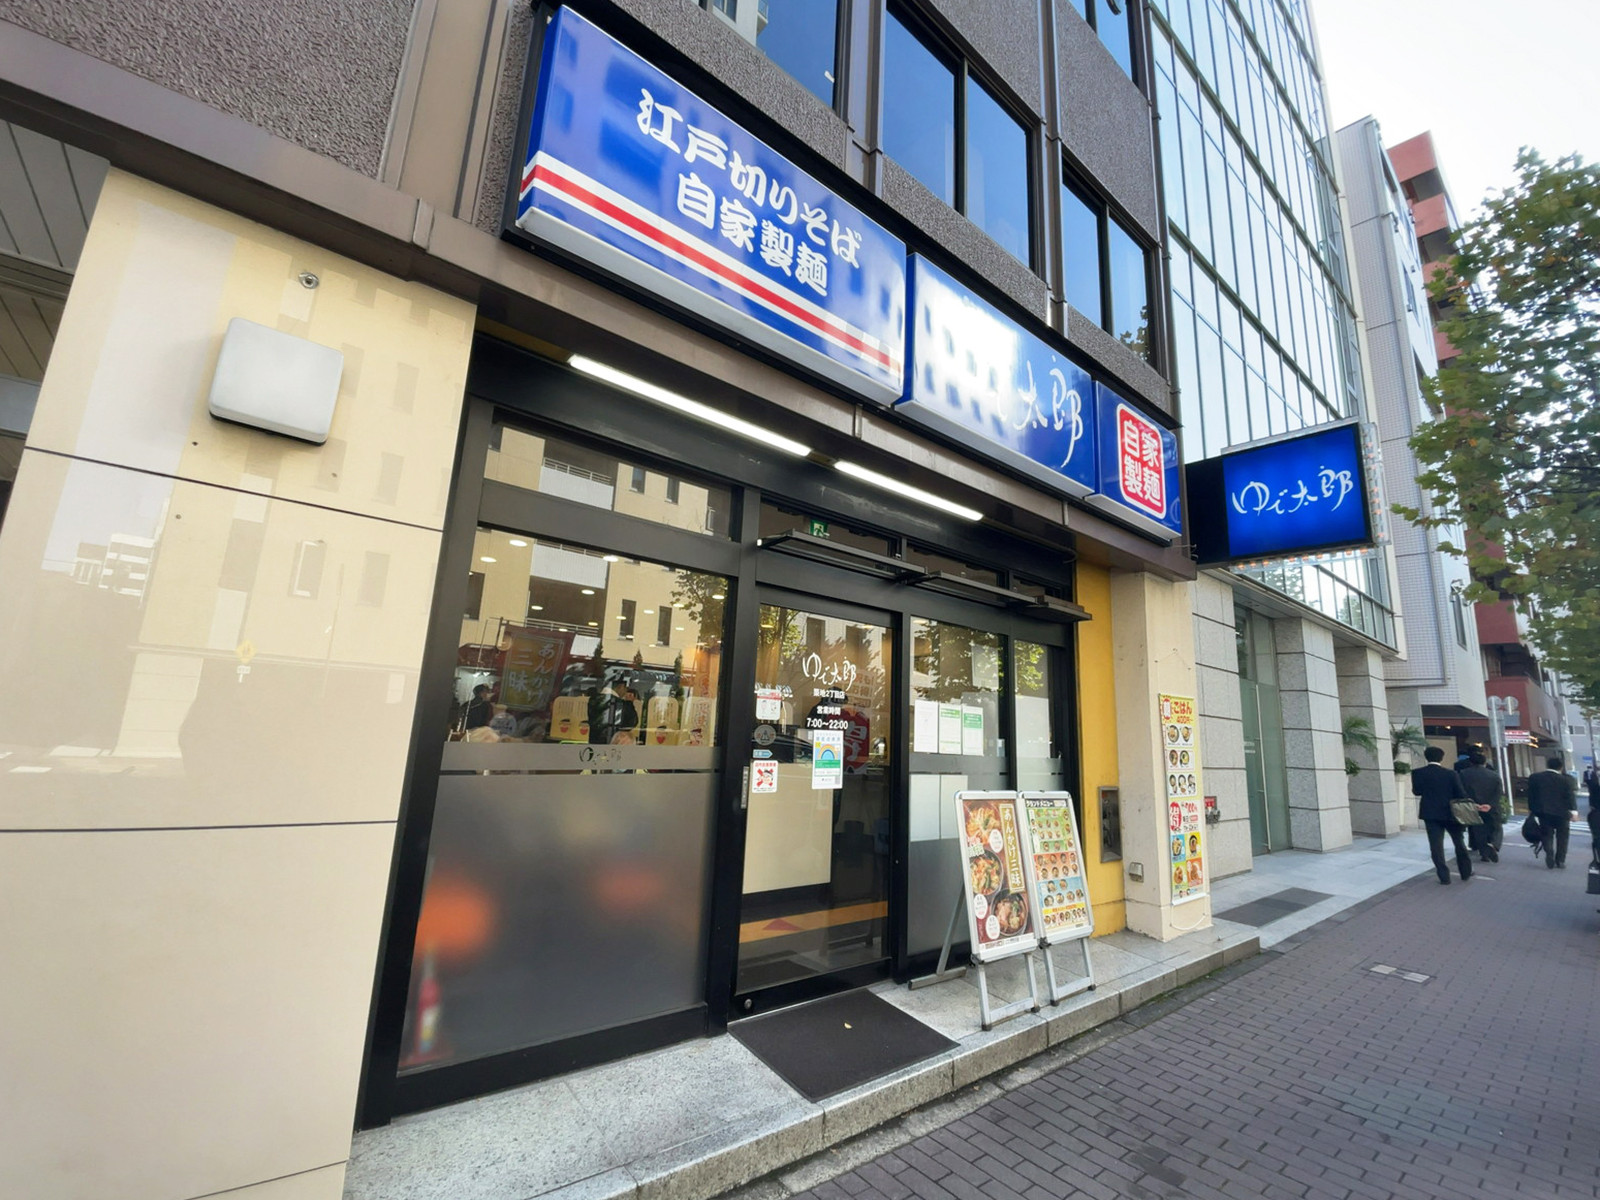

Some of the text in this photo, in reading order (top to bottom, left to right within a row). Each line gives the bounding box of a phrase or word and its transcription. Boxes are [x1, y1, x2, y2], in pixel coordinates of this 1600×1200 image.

[636, 88, 863, 268] 江戸切りそば
[676, 173, 829, 297] 自家製麺
[1232, 465, 1354, 516] ゆで太郎
[802, 652, 857, 692] ゆで太郎
[816, 705, 842, 716] 営業時間
[1173, 701, 1193, 714] ごはん
[1004, 808, 1022, 887] あんかけ三昧
